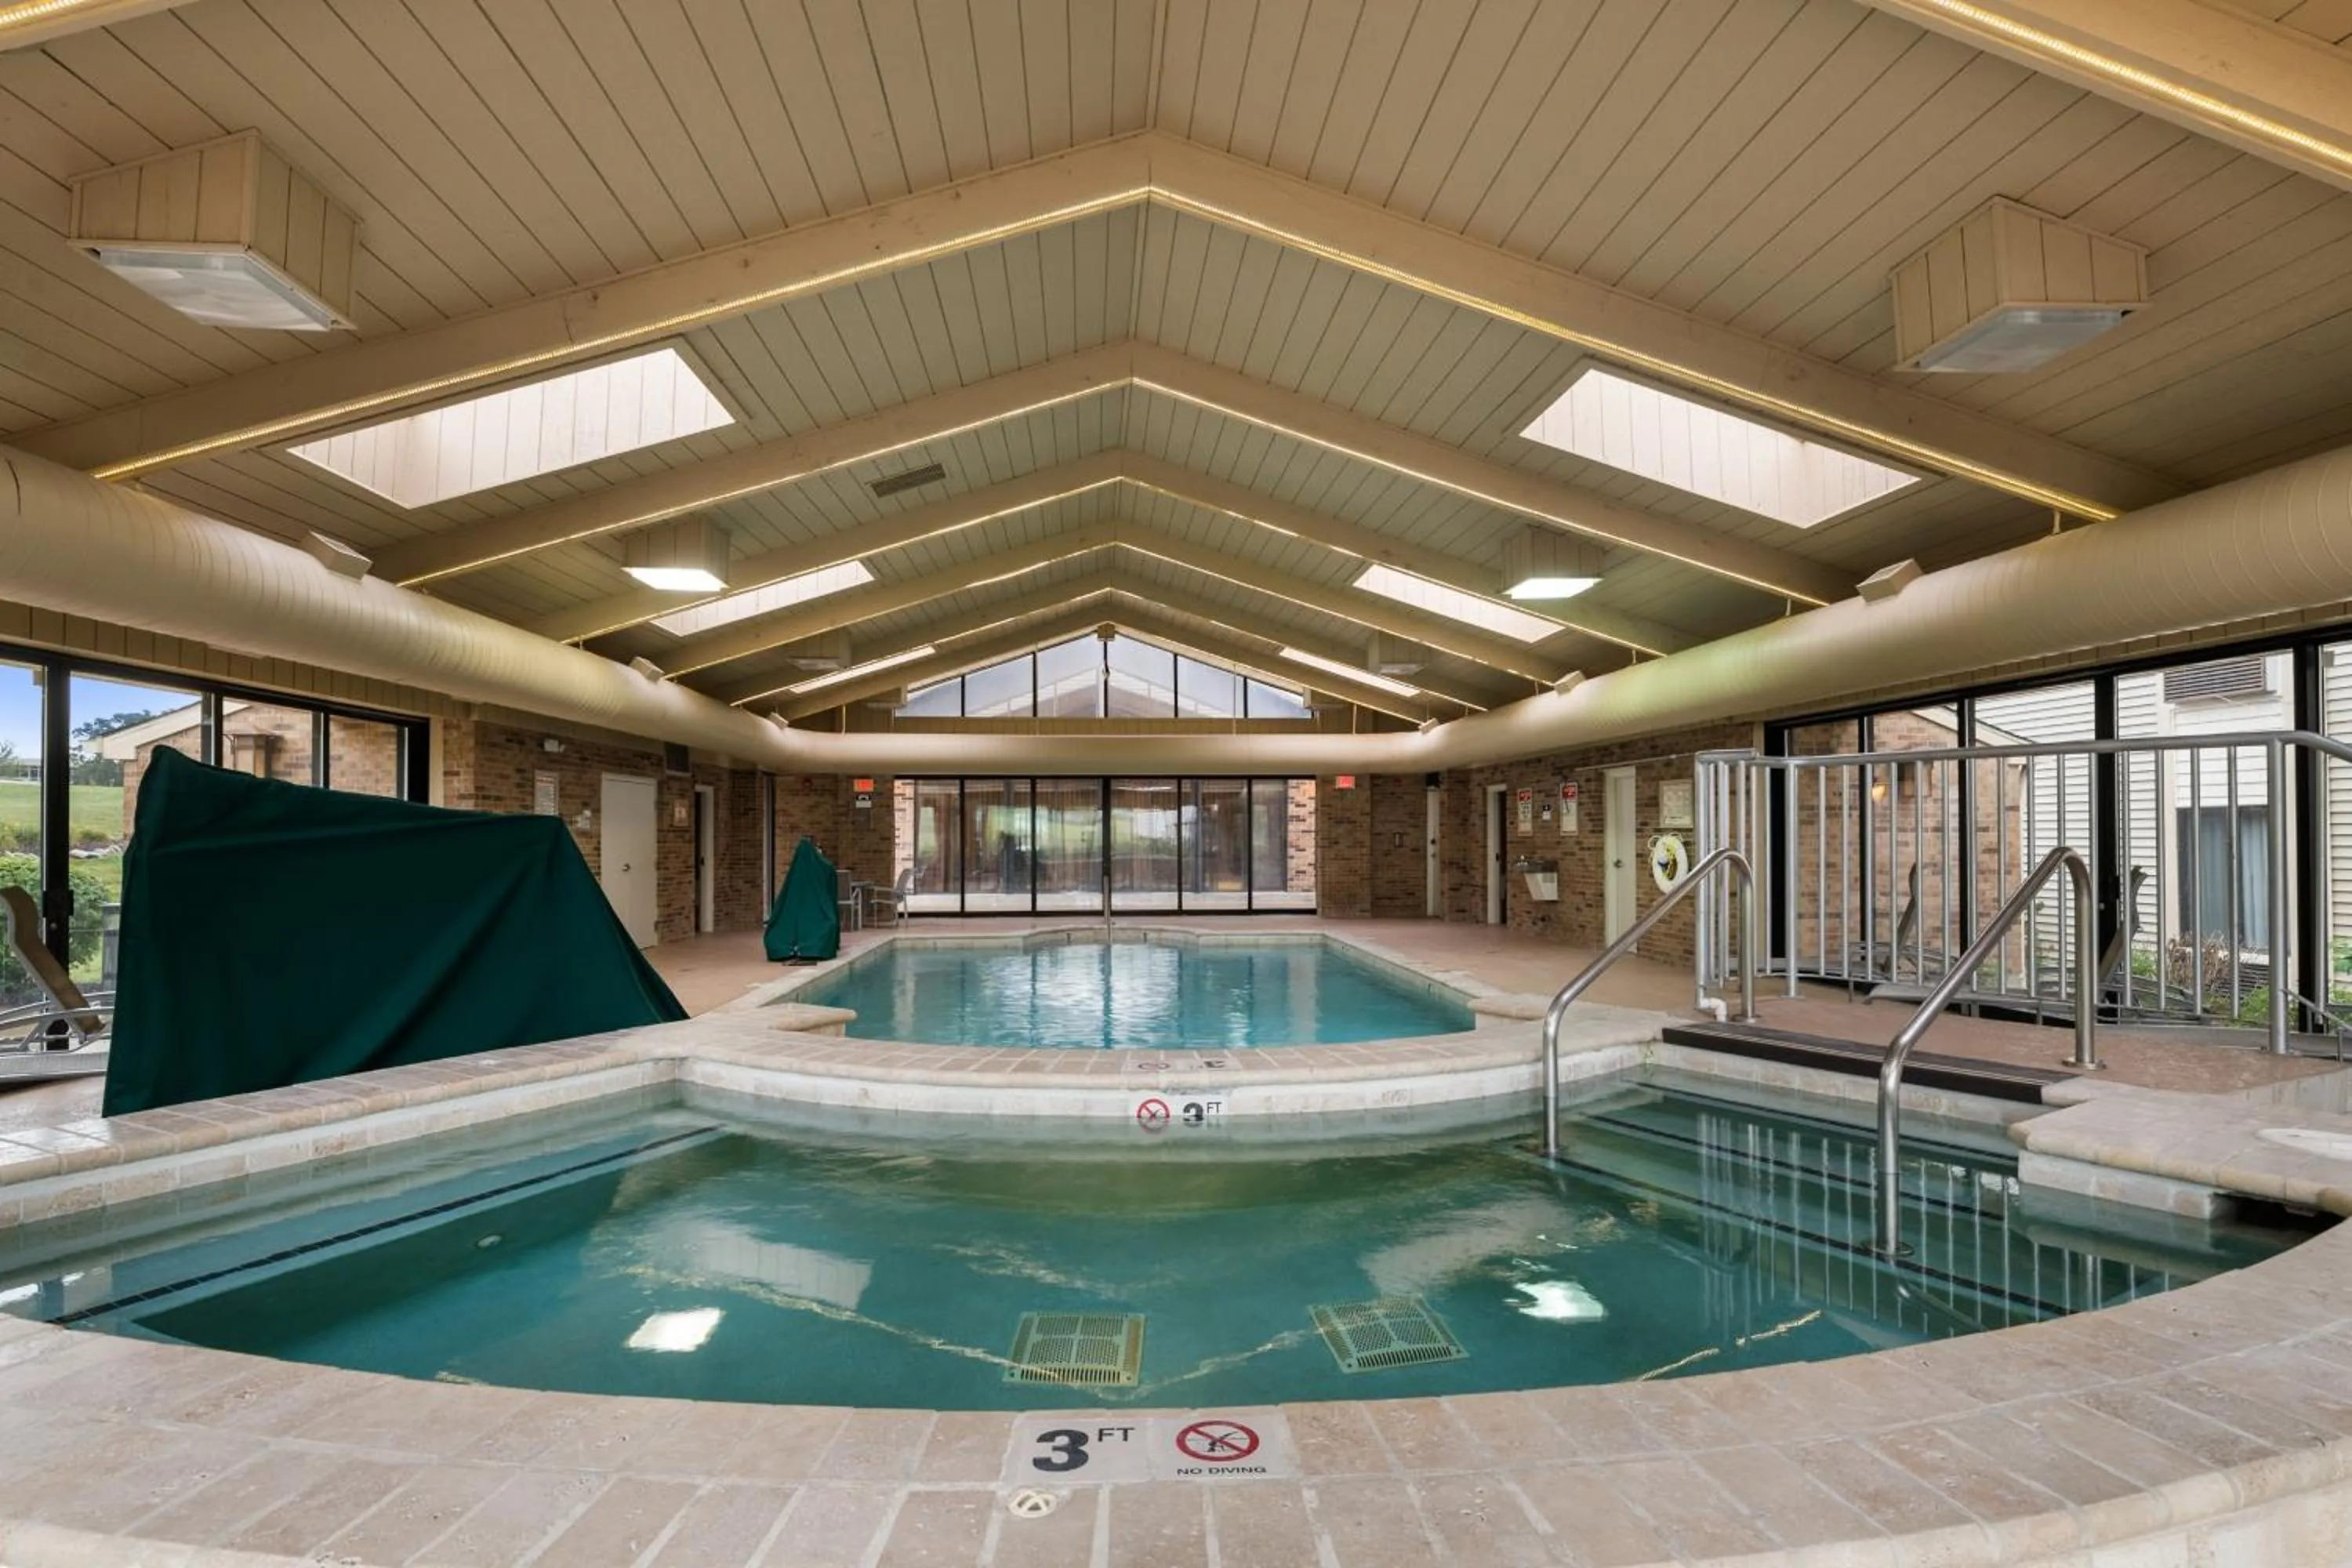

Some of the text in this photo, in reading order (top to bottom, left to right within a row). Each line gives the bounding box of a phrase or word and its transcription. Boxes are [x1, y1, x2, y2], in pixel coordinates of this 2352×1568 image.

[1207, 1102, 1222, 1114] FT
[1032, 1427, 1135, 1472] 3 FT
[1176, 1466, 1267, 1475] NO DIVING
